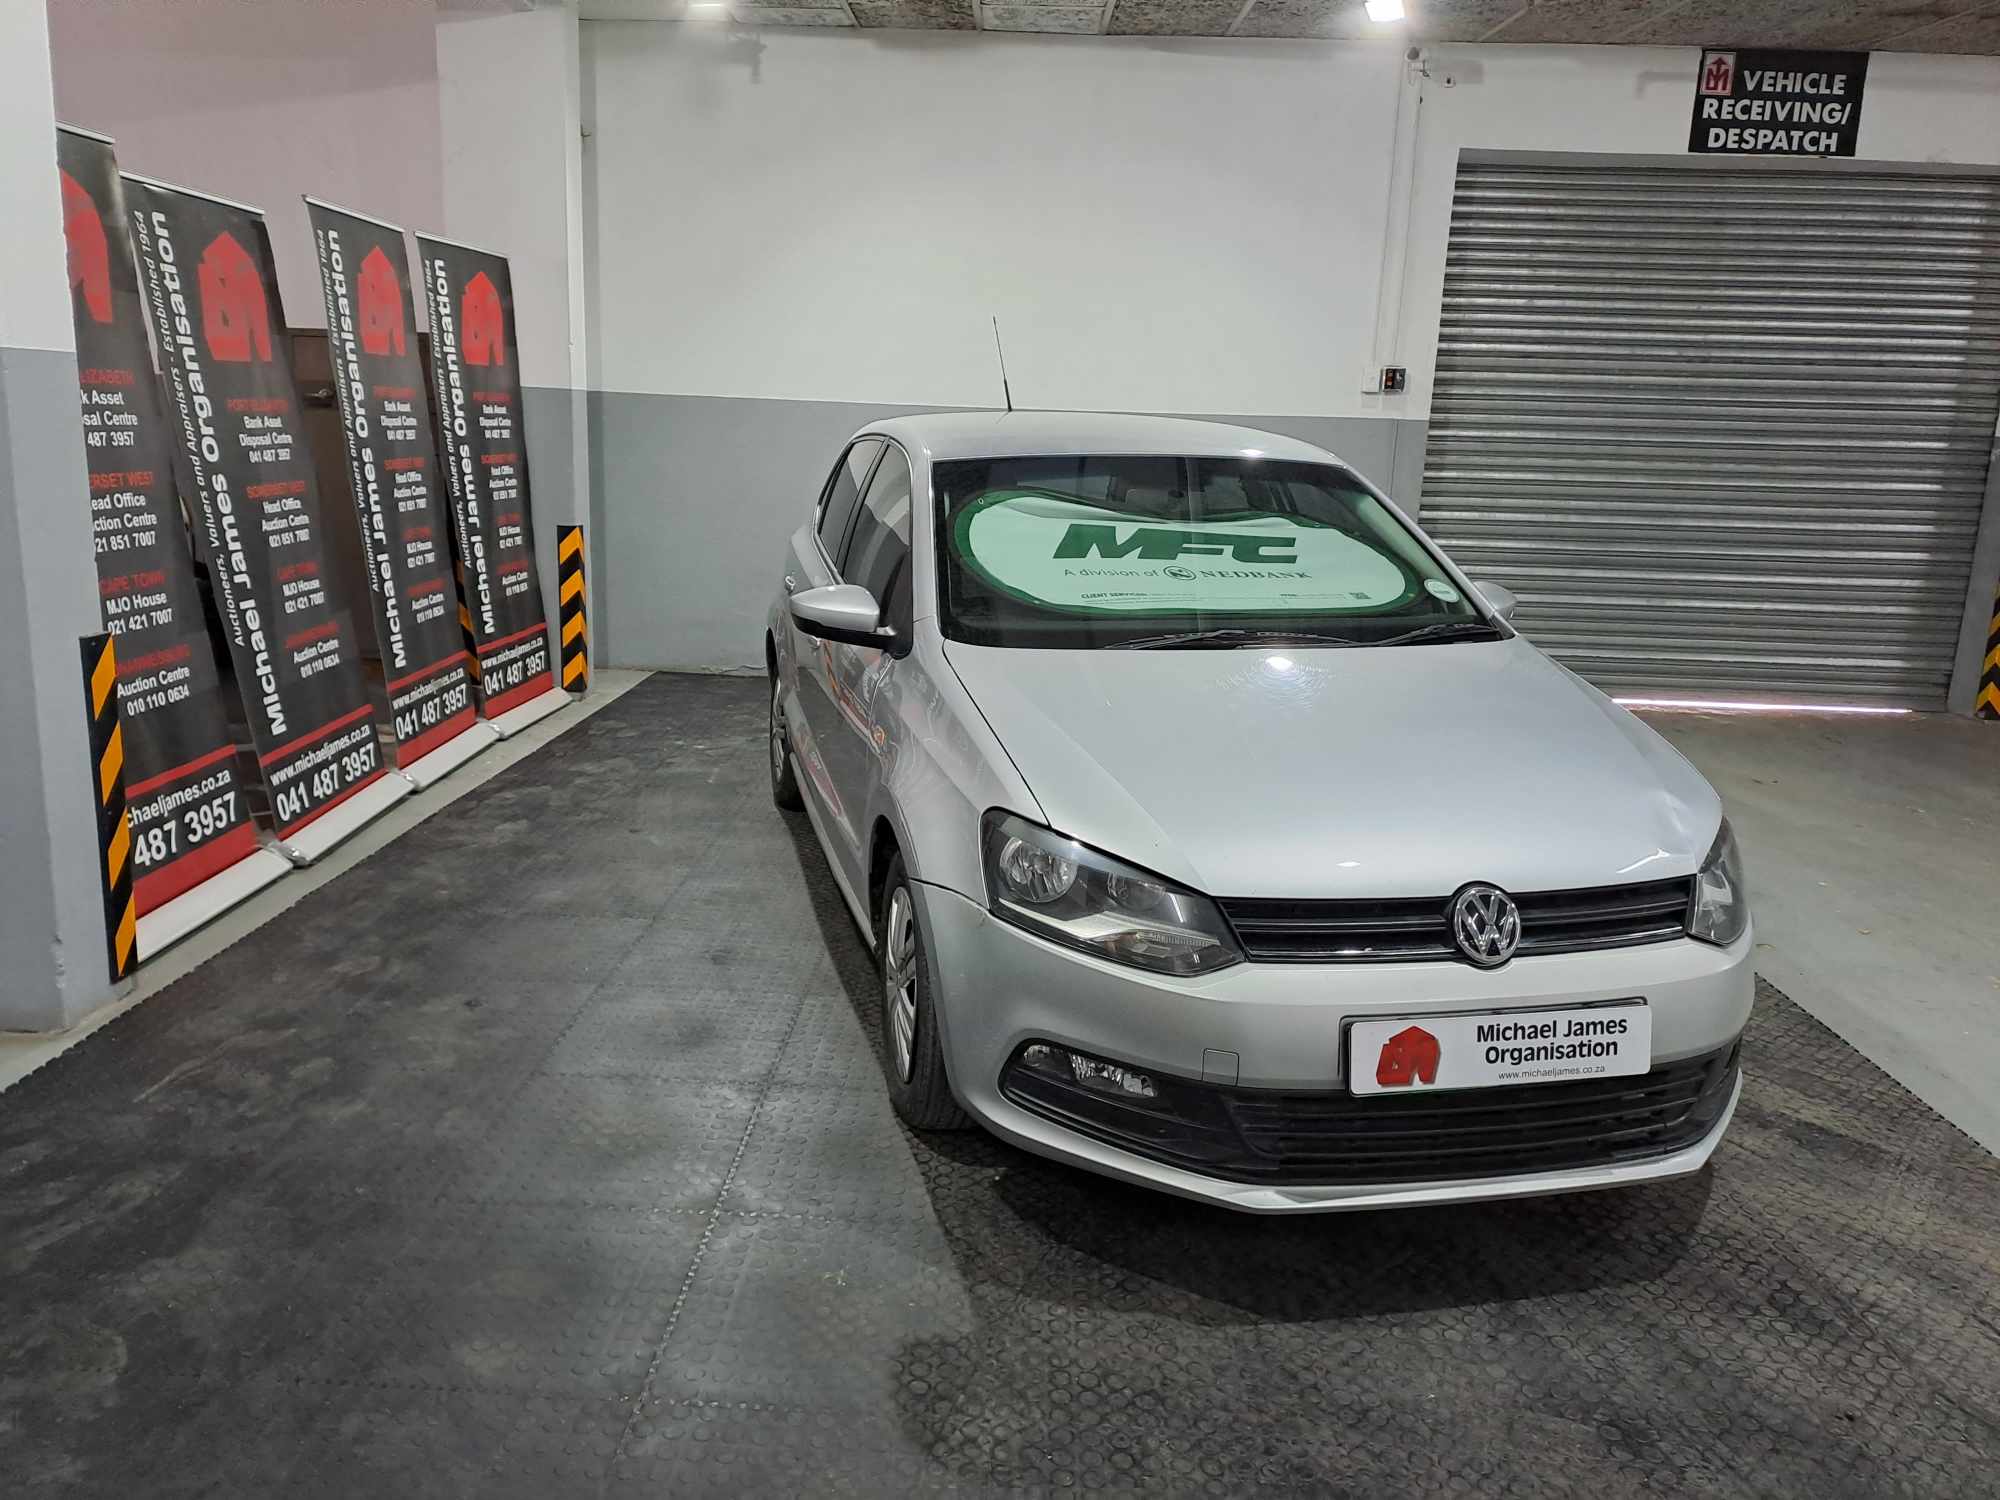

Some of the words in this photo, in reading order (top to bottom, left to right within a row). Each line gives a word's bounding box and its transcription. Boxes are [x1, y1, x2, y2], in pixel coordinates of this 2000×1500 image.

[1743, 70, 1847, 95] VEHICLE
[1702, 98, 1852, 125] RECEIVING/
[1707, 127, 1839, 153] DESPATCH
[133, 209, 152, 253] 1964
[144, 259, 175, 353] Established
[324, 264, 341, 346] Established
[428, 292, 442, 359] Established
[151, 211, 220, 463] Organisation
[328, 229, 369, 438] Organisation
[433, 259, 467, 437] Organisation
[91, 389, 125, 405] Asset
[170, 366, 199, 452] Appraisers
[336, 358, 353, 428] Appraisers
[434, 368, 452, 428] Appraisers
[87, 431, 107, 447] 487
[110, 431, 134, 446] 3957
[103, 410, 138, 426] Centre
[345, 431, 357, 457] and
[444, 431, 455, 453] and
[189, 455, 206, 486] and
[352, 460, 366, 509] Valuers
[448, 456, 462, 497] Valuers
[459, 444, 480, 529] James
[113, 492, 146, 508] Office
[199, 490, 221, 548] Valuers
[361, 447, 387, 545] James
[109, 534, 131, 551] 851
[132, 530, 156, 547] 7007
[123, 512, 158, 528] Centre
[211, 473, 252, 589] James
[456, 501, 472, 568] Auctioneers,
[1052, 523, 1299, 564] MFC
[361, 513, 380, 592] Auctioneers,
[1064, 568, 1076, 577] A
[1079, 568, 1141, 577] division
[1143, 568, 1160, 577] of
[1199, 570, 1313, 579] NEDBANK
[106, 597, 130, 615] MJO
[132, 592, 168, 609] House
[215, 554, 245, 647] Auctioneers,
[470, 535, 496, 635] Michael
[107, 618, 127, 636] 021
[128, 613, 149, 631] 421
[150, 608, 173, 627] 7007
[376, 553, 407, 669] Michael
[117, 676, 157, 699] Auction
[158, 665, 191, 685] Centre
[239, 599, 288, 736] Michael
[484, 670, 505, 696] 041
[506, 660, 523, 686] 487
[525, 650, 545, 677] 3957
[126, 698, 145, 717] 010
[145, 691, 166, 710] 110
[395, 709, 420, 740] 041
[421, 698, 441, 728] 487
[443, 682, 467, 714] 3957
[270, 723, 371, 787] www.michaeljames.co.za
[276, 785, 310, 822] 041
[312, 762, 340, 800] 487
[341, 742, 377, 783] 3957
[134, 820, 177, 866] 487
[184, 791, 236, 845] 3957
[1476, 1022, 1557, 1044] Michael
[1562, 1018, 1628, 1038] James
[1485, 1039, 1618, 1065] Organisation
[1497, 1065, 1606, 1081] www.michaeljames.co.za
